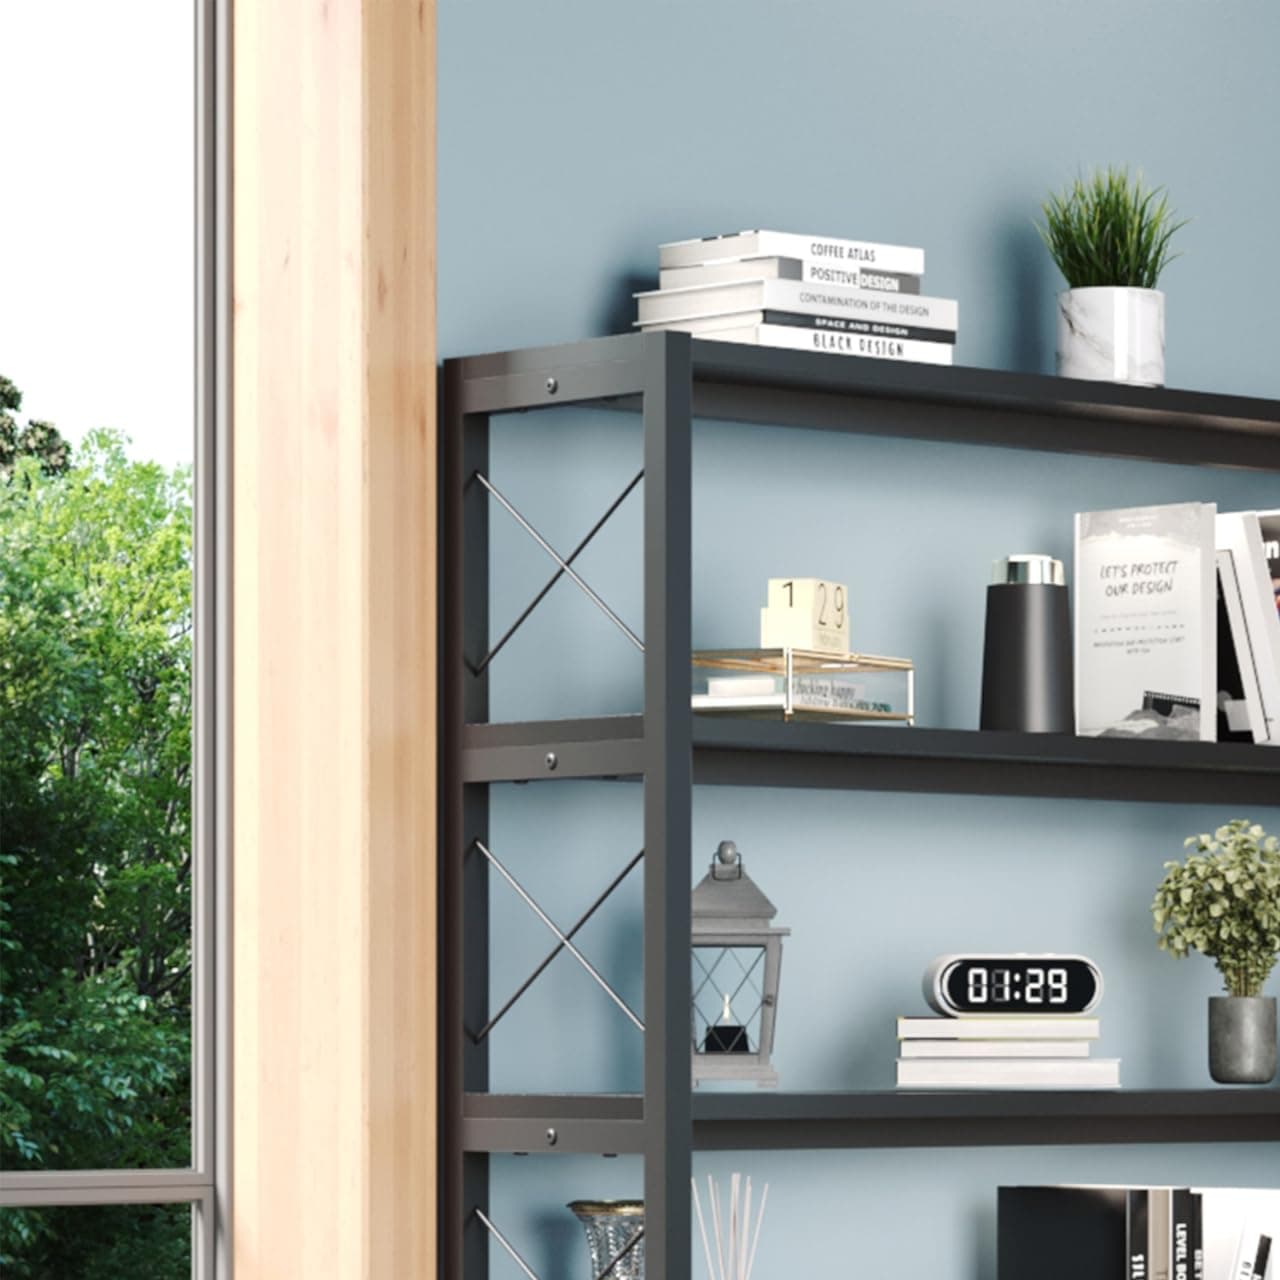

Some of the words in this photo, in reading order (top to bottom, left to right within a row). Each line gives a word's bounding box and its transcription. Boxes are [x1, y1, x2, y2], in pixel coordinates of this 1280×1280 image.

[811, 243, 845, 259] COFFEE
[848, 246, 876, 263] ATLAS
[810, 266, 858, 286] POSITIVE
[860, 273, 899, 291] DESIGN
[800, 292, 868, 311] CONTAMINATION
[869, 299, 881, 312] OF
[882, 300, 897, 314] THE
[899, 302, 929, 317] DESIGN
[816, 317, 846, 329] SPACE
[849, 320, 869, 332] AND
[872, 323, 909, 336] DESIGN
[814, 333, 853, 352] BLACK
[859, 337, 904, 356] DESIGN
[1131, 560, 1178, 577] PROTECT
[782, 581, 794, 608] 1
[1105, 583, 1128, 597] OUR
[1132, 577, 1174, 595] DESIGN
[818, 583, 844, 629] 29
[968, 967, 1068, 1003] 01:29
[1176, 1223, 1187, 1262] LEVEL
